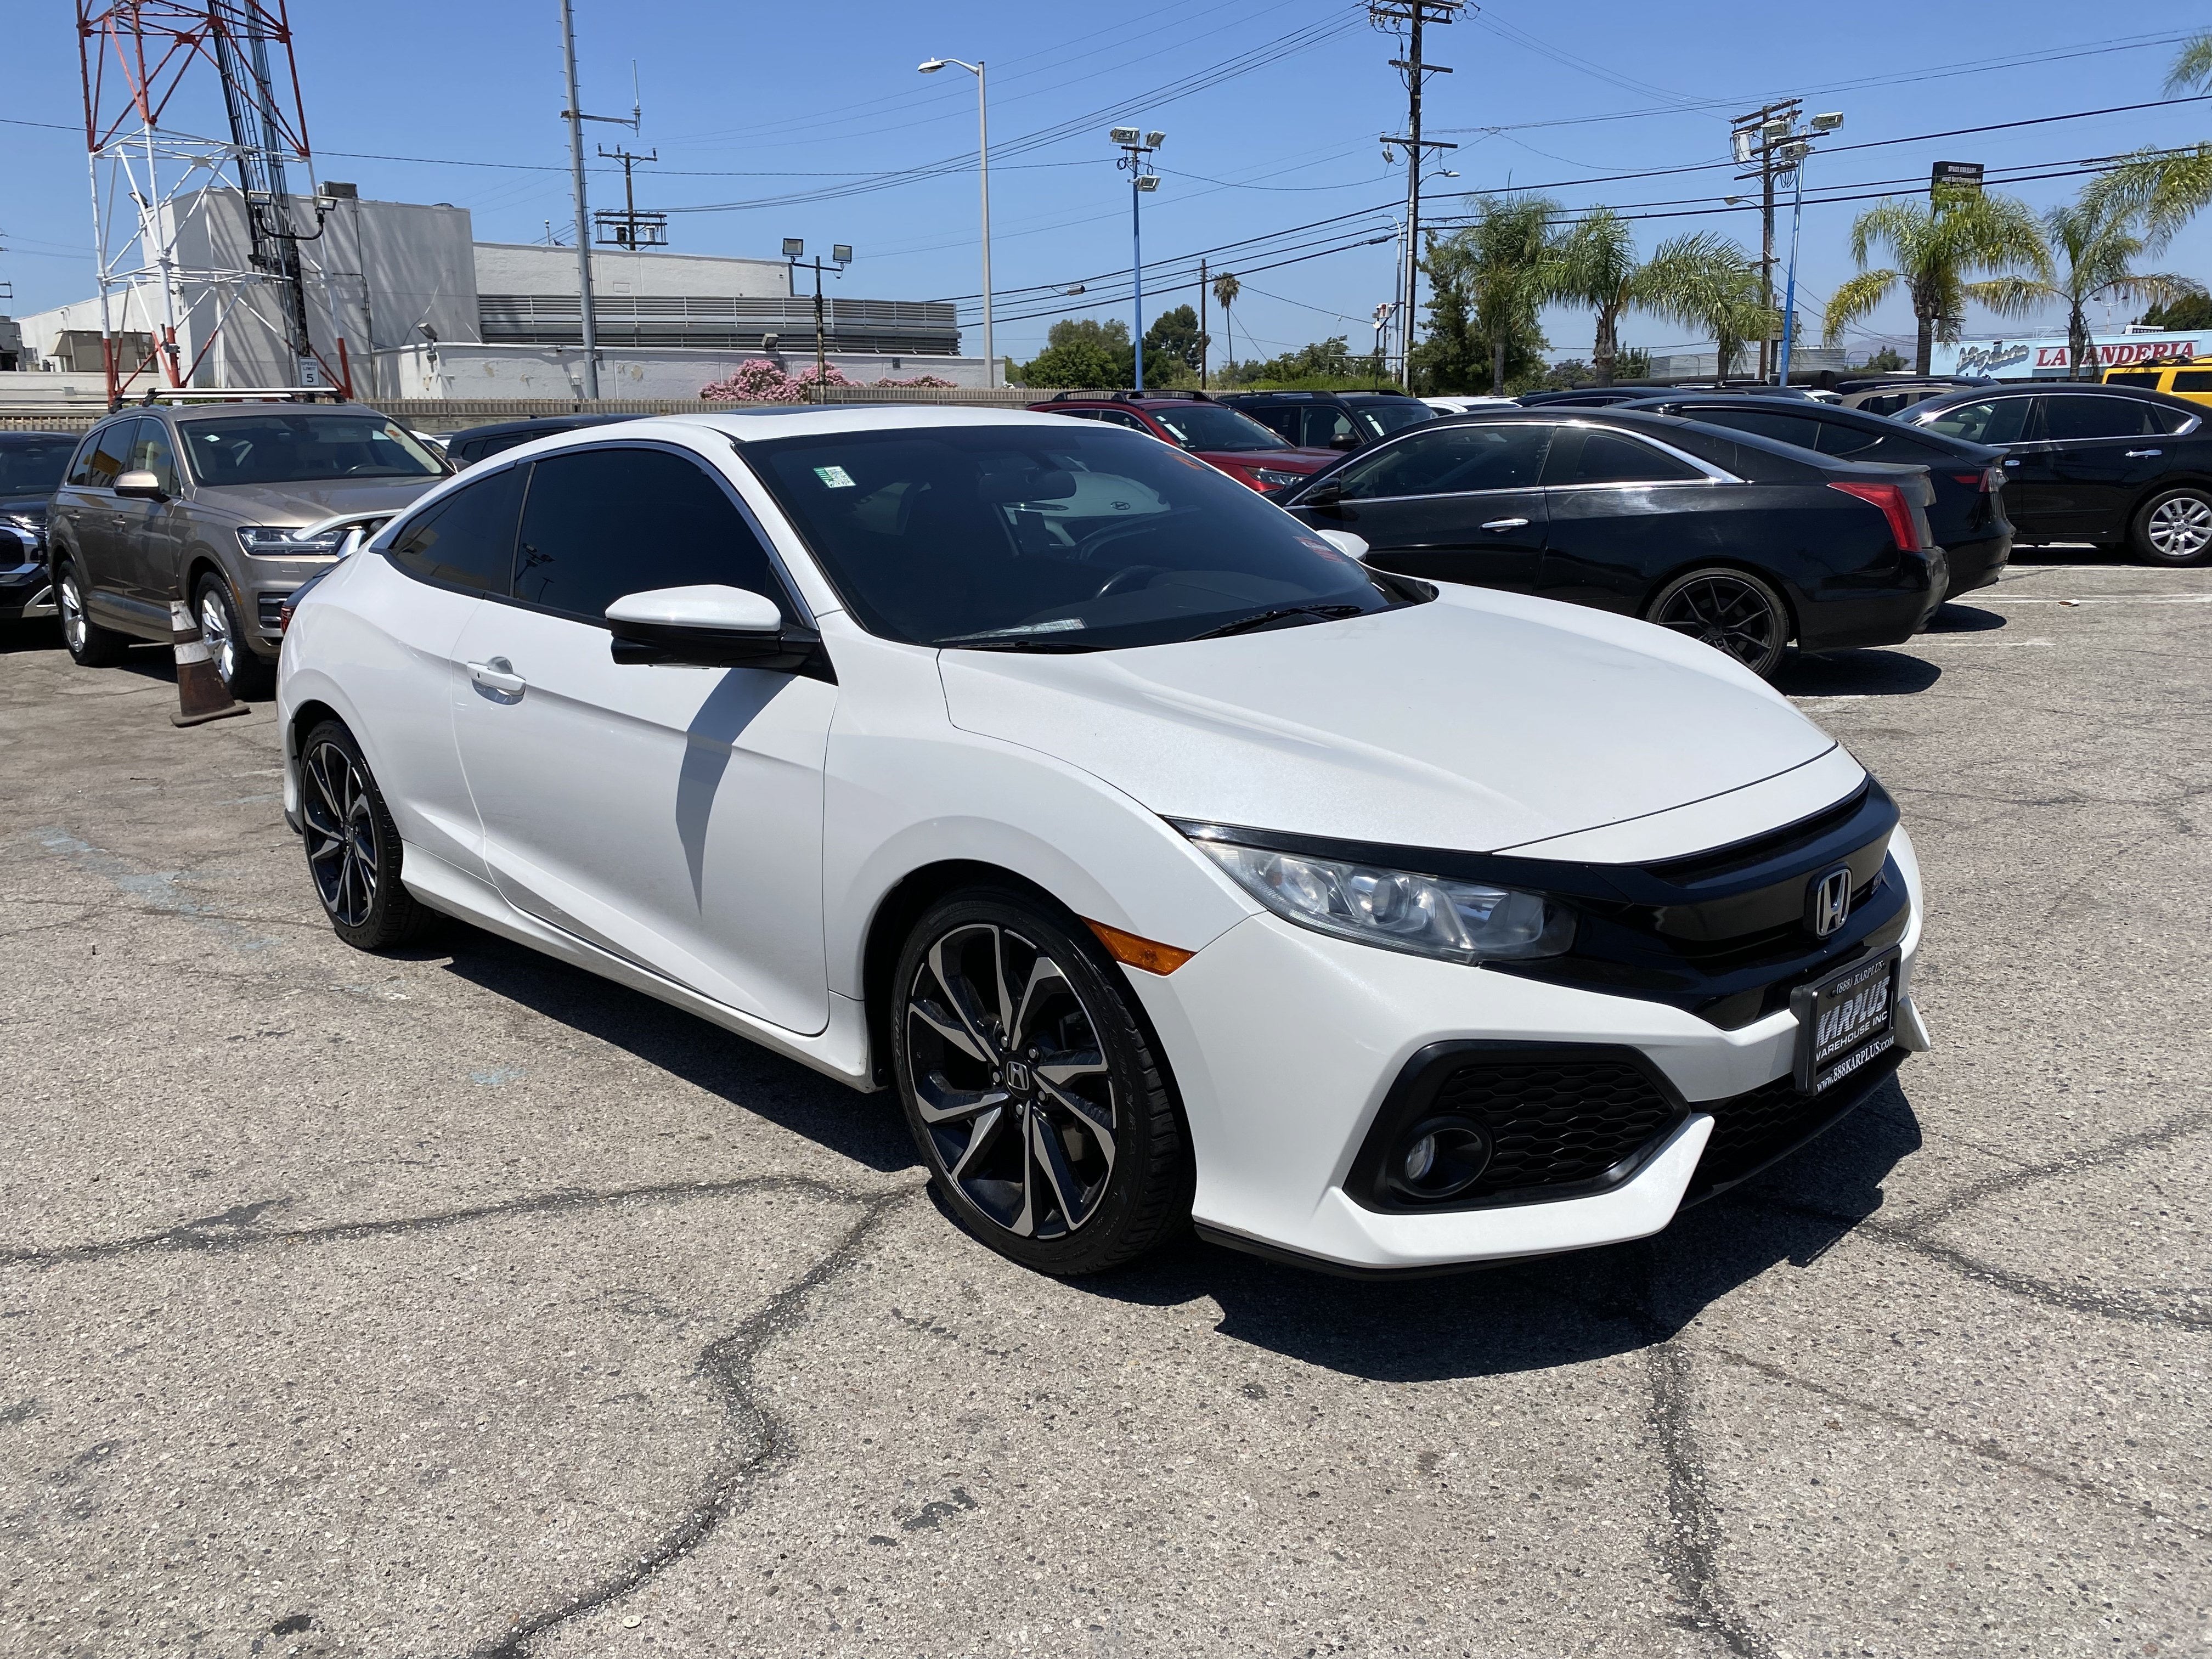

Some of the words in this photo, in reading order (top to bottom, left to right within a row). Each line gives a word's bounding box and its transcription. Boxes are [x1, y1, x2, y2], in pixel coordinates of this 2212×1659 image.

[2036, 343, 2194, 366] LAANDERIA
[307, 374, 314, 382] 5
[1836, 979, 1853, 994] (888)
[1816, 975, 1891, 1048] KARPLUS
[1872, 1011, 1887, 1026] INC
